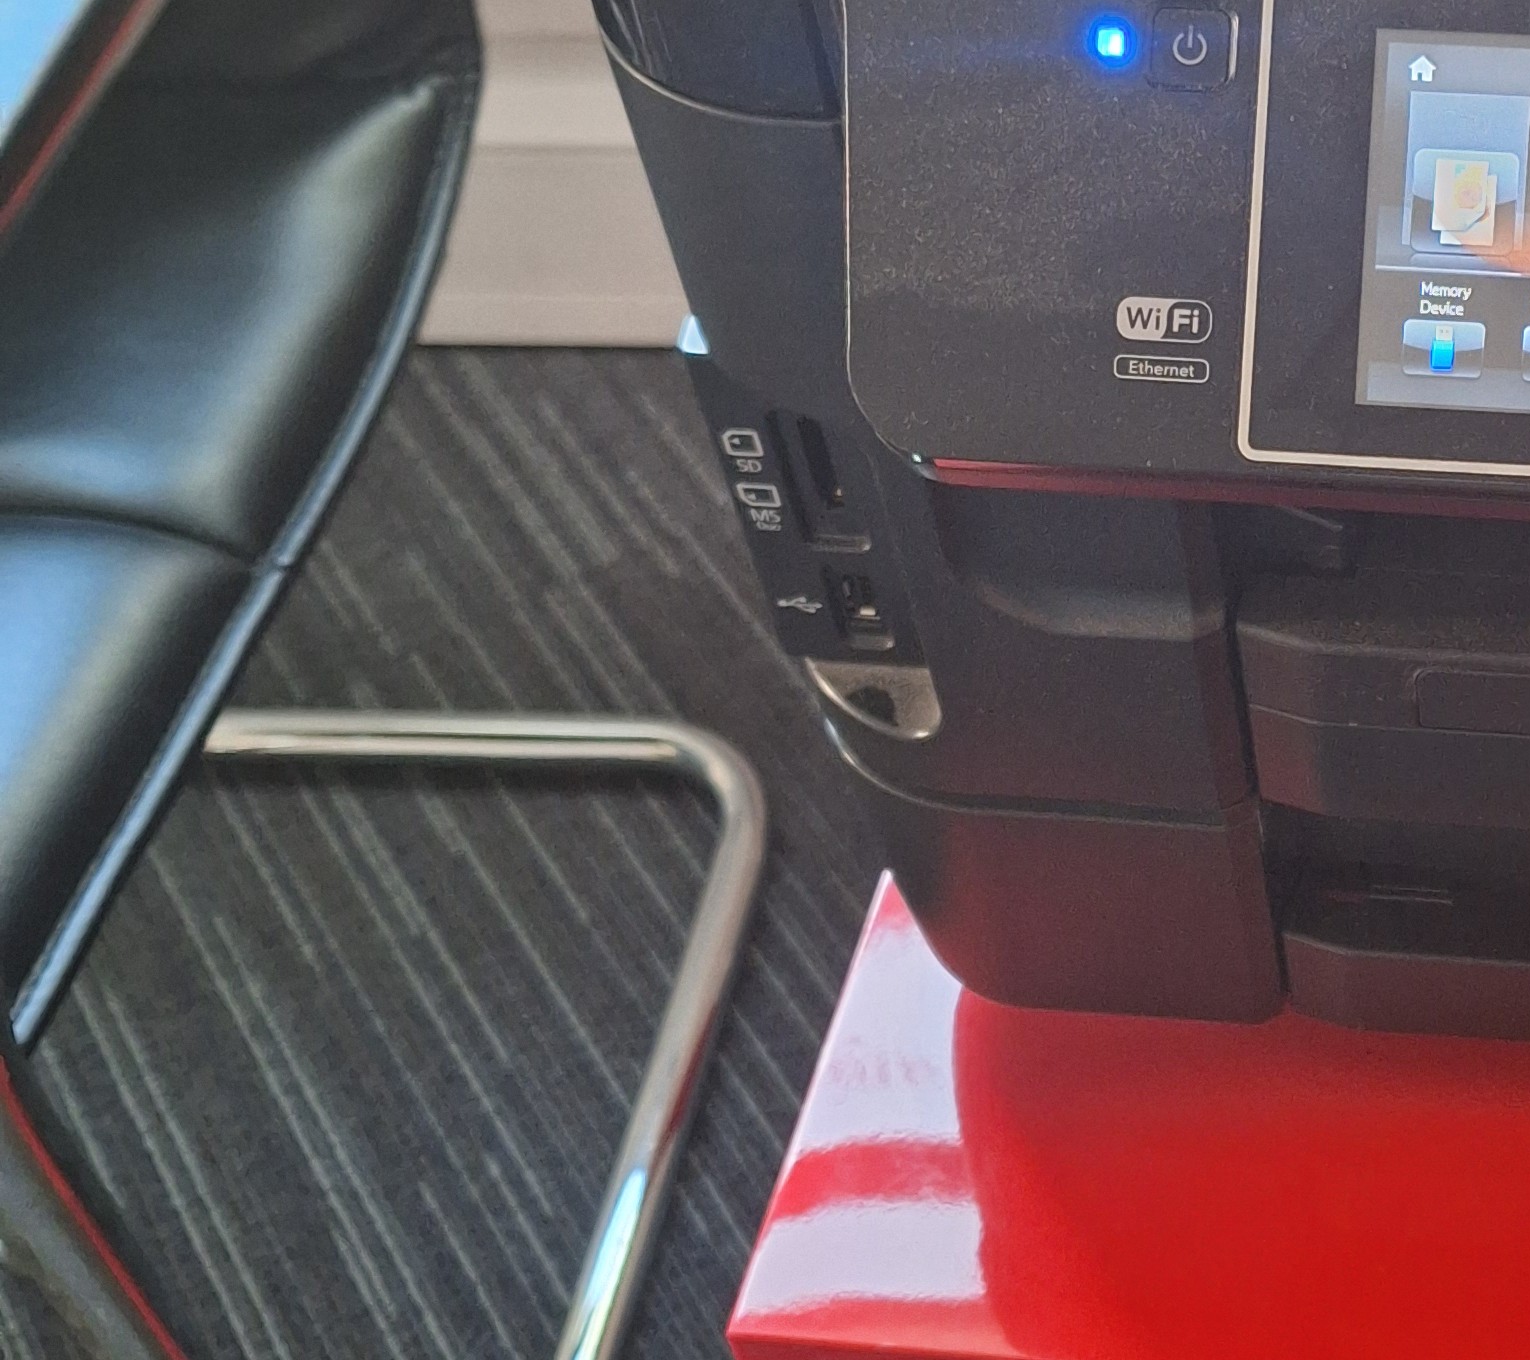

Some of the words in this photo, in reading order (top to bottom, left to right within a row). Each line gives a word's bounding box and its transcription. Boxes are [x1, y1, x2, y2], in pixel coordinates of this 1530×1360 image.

[1420, 281, 1472, 301] Memory
[1419, 299, 1465, 316] Device
[1128, 360, 1195, 378] Ethernet
[736, 459, 762, 473] SD
[750, 507, 782, 523] MS
